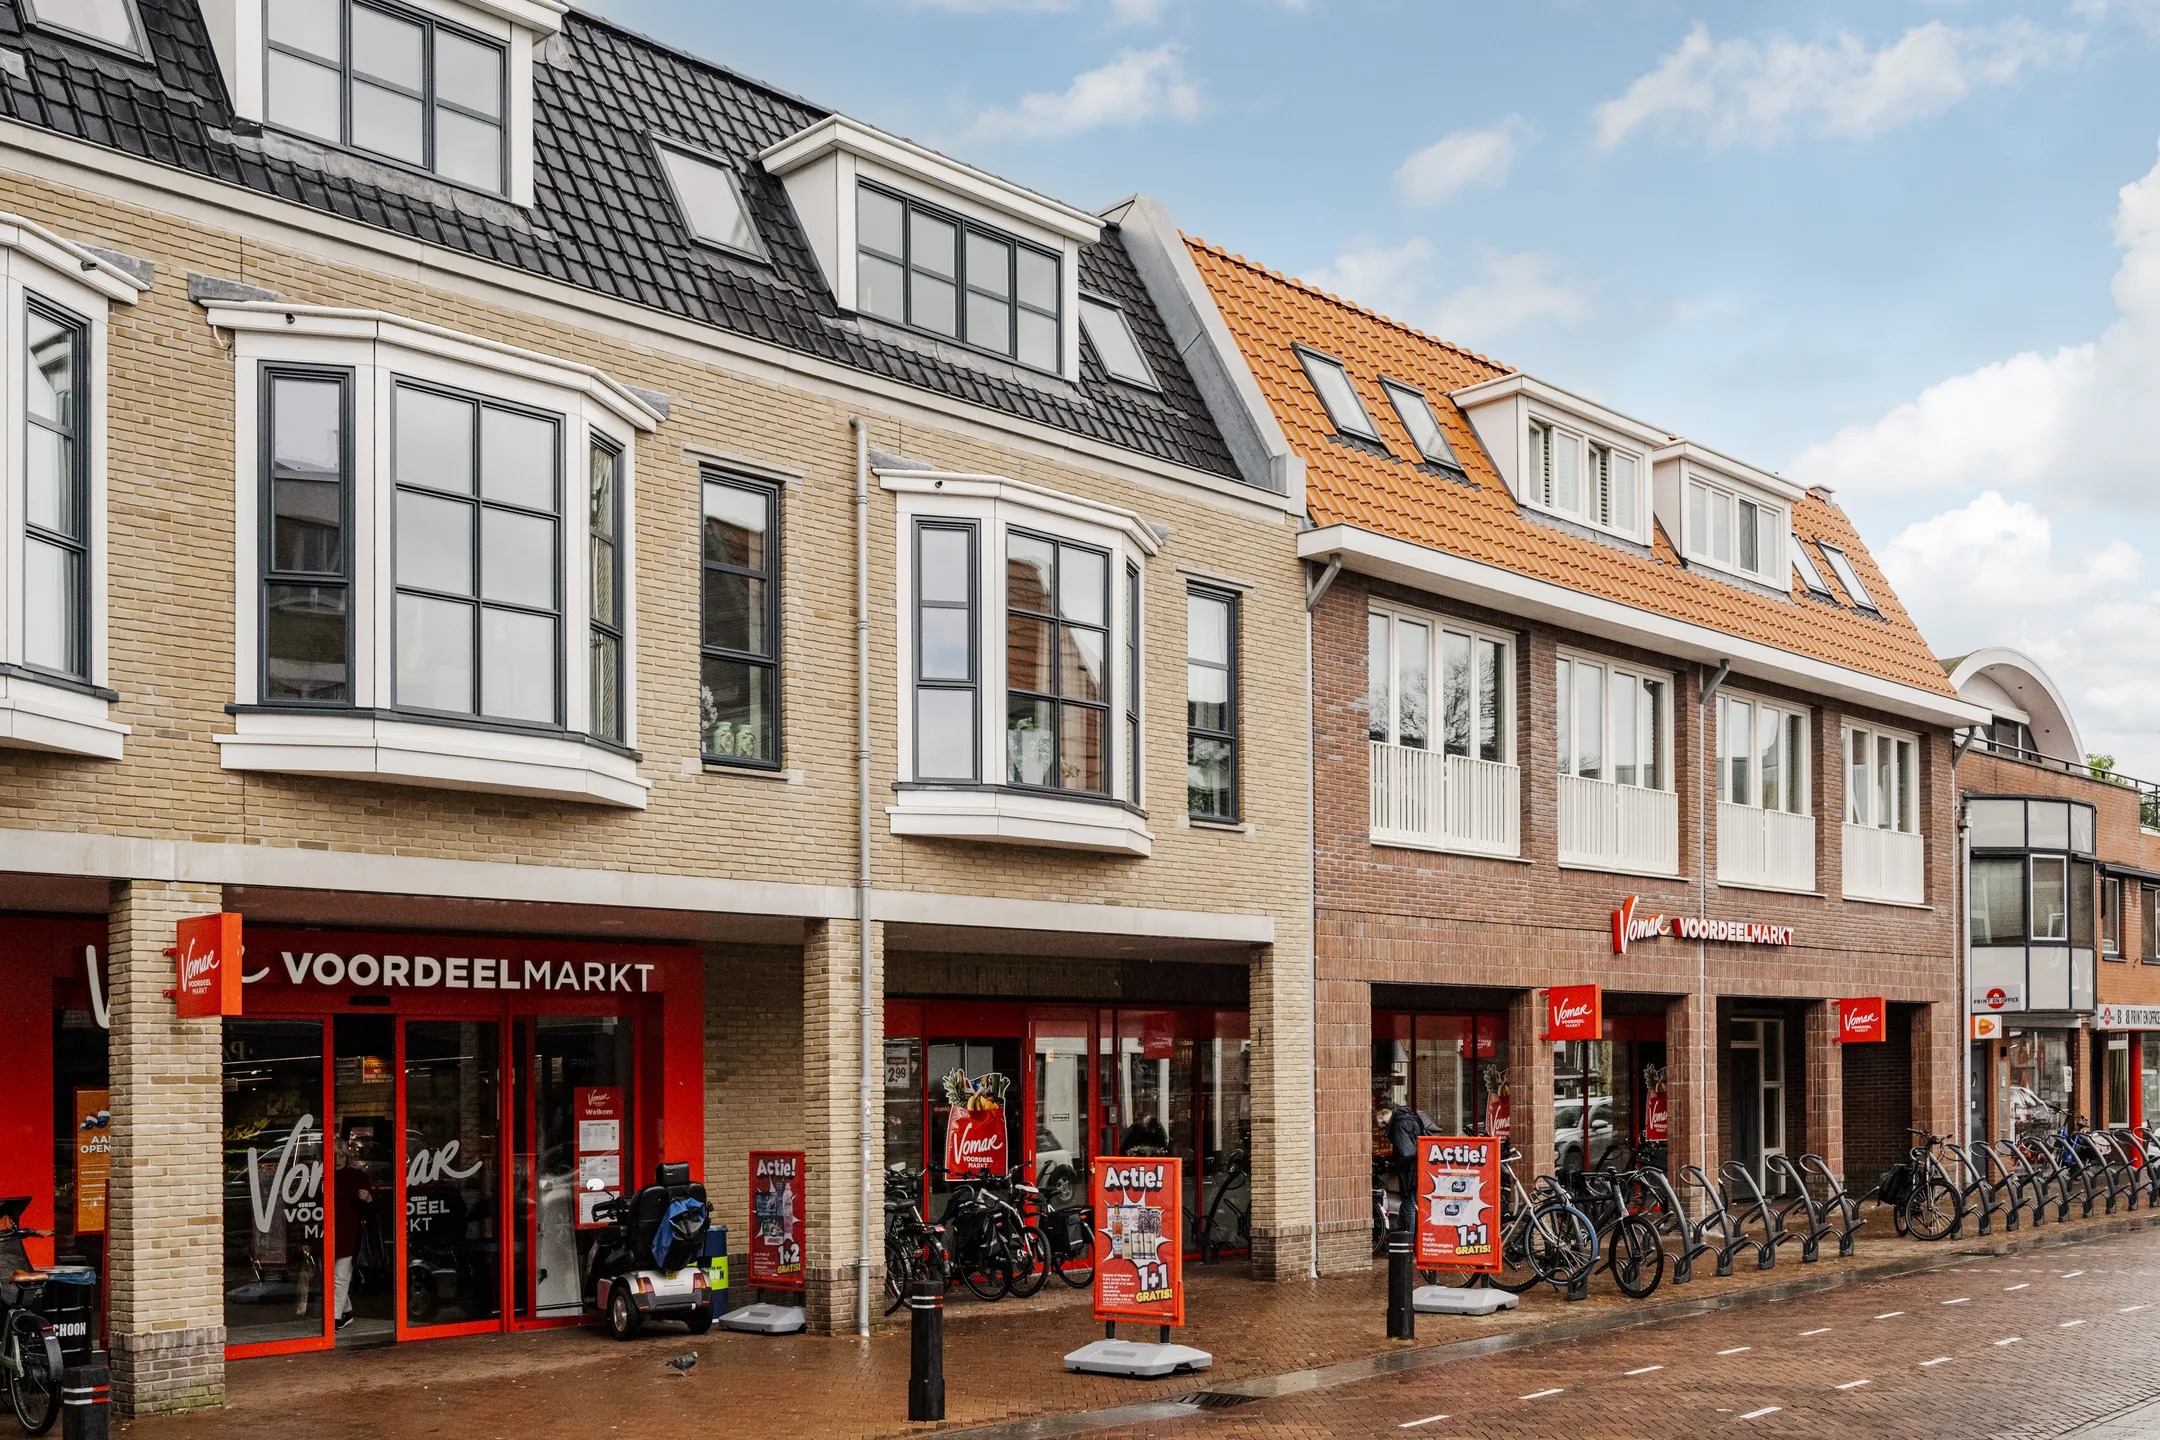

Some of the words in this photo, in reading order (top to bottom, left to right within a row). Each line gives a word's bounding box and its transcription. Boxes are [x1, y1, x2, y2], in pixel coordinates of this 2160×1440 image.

[1676, 917, 1794, 945] VOORDEELMARKT
[281, 951, 655, 992] VOORDEELMARKT
[188, 978, 211, 987] VOORDEEL
[192, 987, 207, 995] MARKT
[887, 1067, 906, 1083] 2,99
[962, 1155, 993, 1163] VOORDEEL
[1428, 1144, 1488, 1165] Actie!
[756, 1157, 796, 1178] Actie!
[1104, 1165, 1164, 1192] Actie!
[1458, 1223, 1487, 1247] 1+1
[778, 1243, 800, 1265] 1+2
[1455, 1245, 1491, 1256] GRATIS!
[777, 1262, 801, 1275] GRATIS!
[1138, 1263, 1169, 1292] 1+1
[1135, 1288, 1173, 1303] GRATIS!
